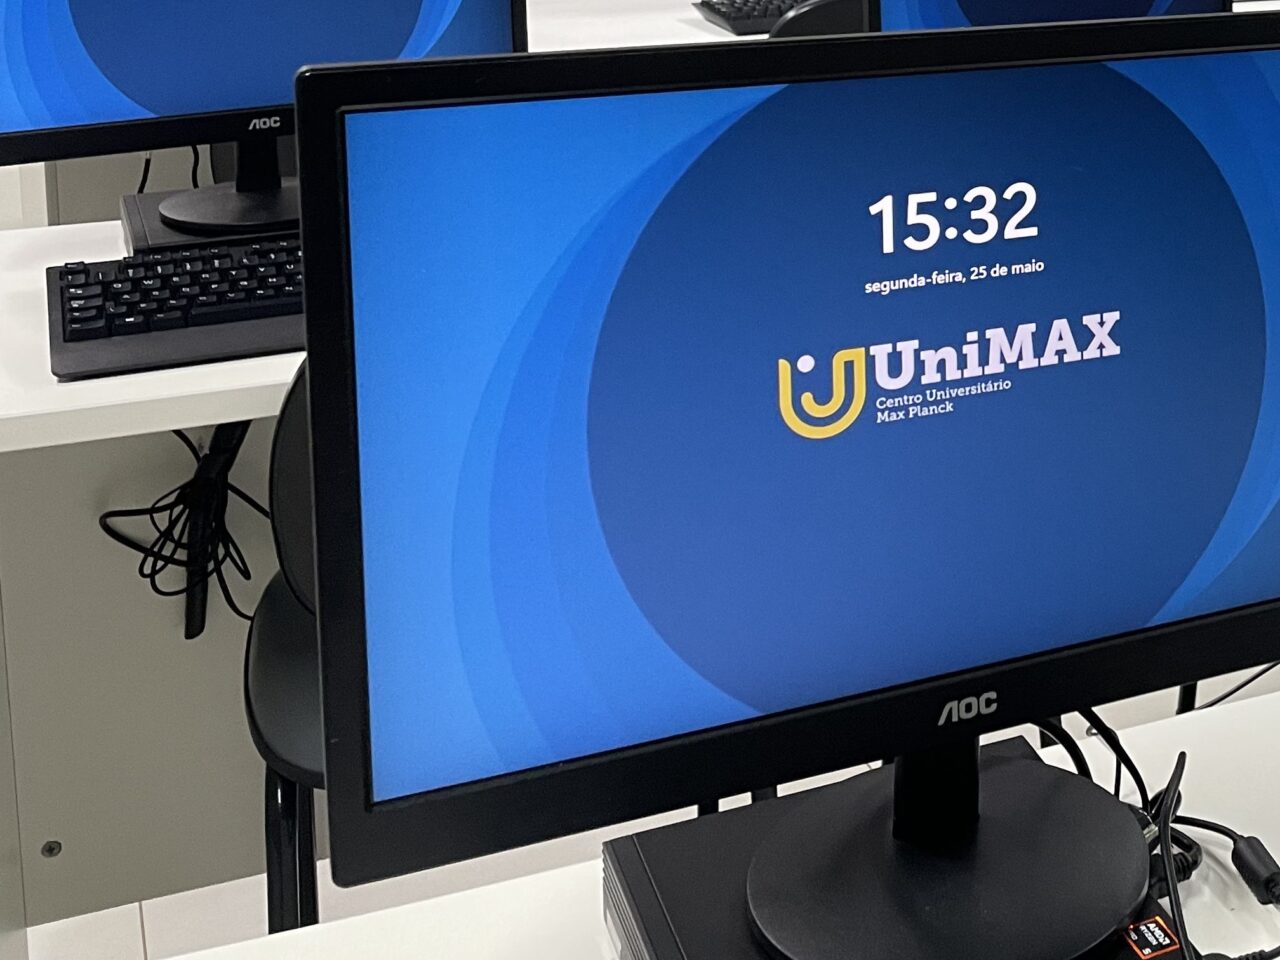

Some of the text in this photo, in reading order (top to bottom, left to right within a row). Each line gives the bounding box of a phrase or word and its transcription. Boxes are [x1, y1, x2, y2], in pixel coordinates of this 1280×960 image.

[248, 116, 281, 130] AOC
[868, 181, 1039, 254] 15:32
[864, 259, 1045, 295] segunda-feira, 25 de maio
[869, 311, 1121, 390] UniMAX
[876, 378, 1012, 410] Centro Universitário
[876, 401, 954, 424] Max Planck
[938, 691, 998, 726] AOC
